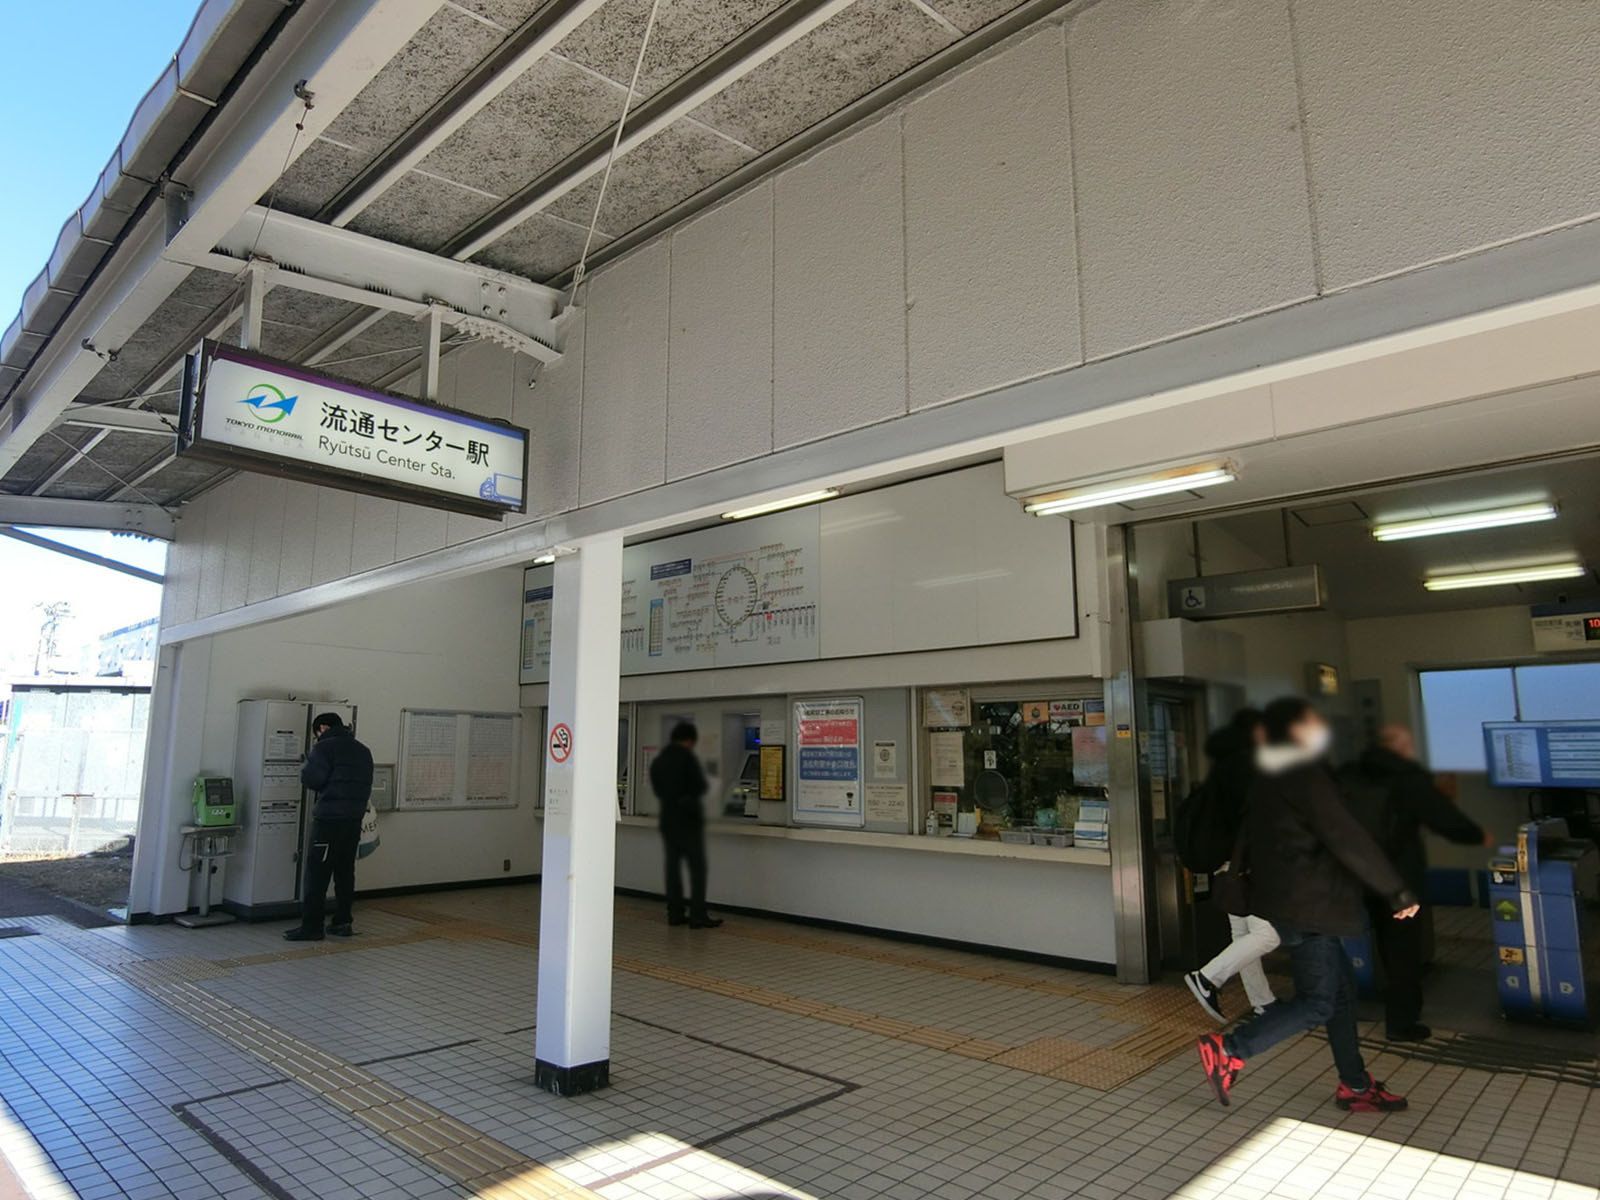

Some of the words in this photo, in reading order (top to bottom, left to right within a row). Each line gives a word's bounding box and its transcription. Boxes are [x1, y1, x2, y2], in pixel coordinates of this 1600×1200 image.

[226, 417, 255, 430] TOKYO
[320, 402, 489, 467] 流通センター駅
[319, 435, 371, 460] Ryūtsū
[377, 449, 426, 472] Center
[431, 462, 456, 480] Sta.
[1061, 703, 1080, 711] AED
